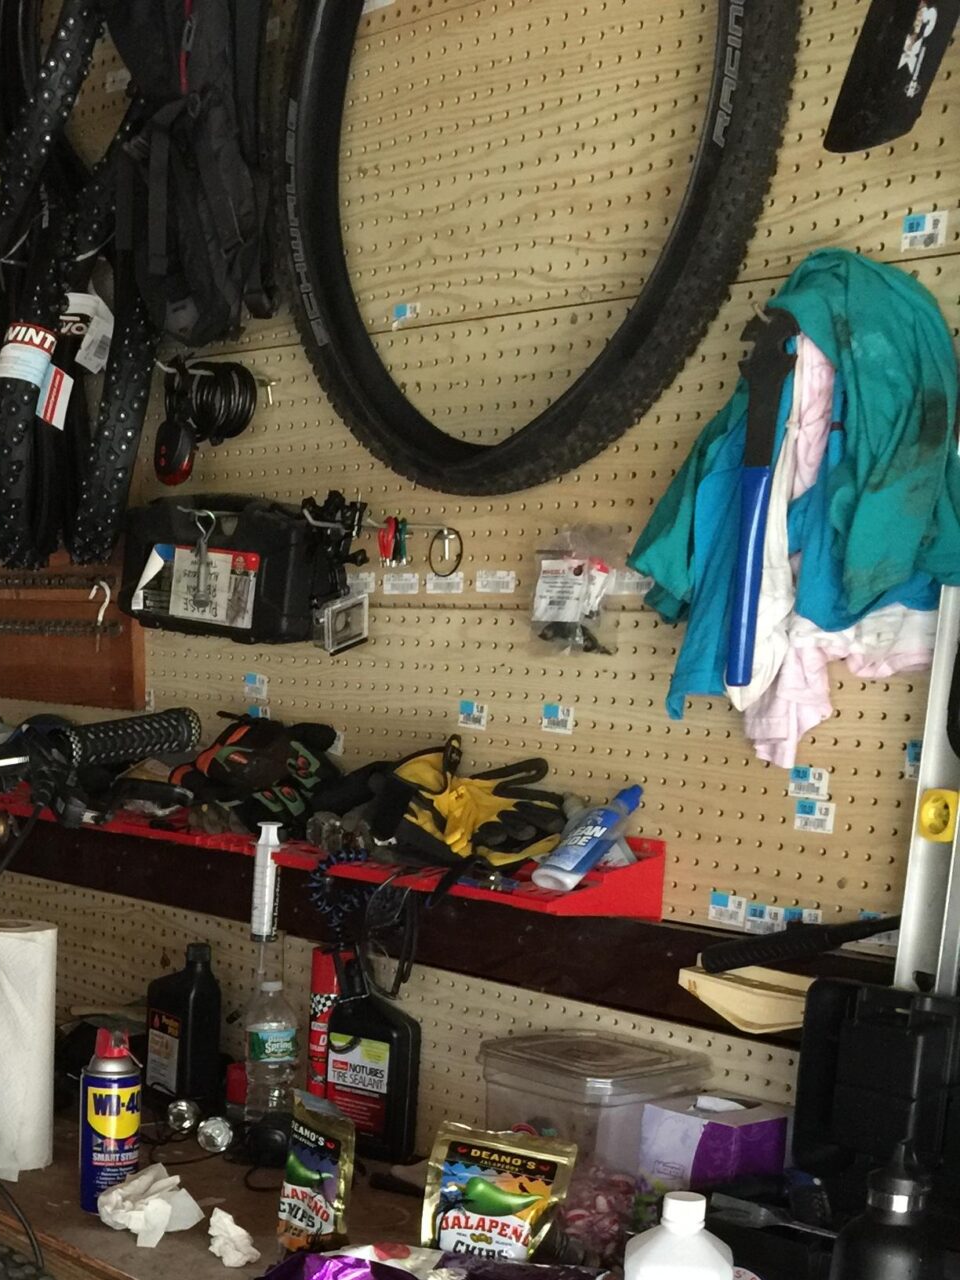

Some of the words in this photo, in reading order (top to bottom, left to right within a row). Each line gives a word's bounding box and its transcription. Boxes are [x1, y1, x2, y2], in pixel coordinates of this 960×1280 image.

[713, 0, 745, 147] RACIN
[4, 325, 58, 355] WINT
[264, 1041, 293, 1054] Spring
[331, 1069, 348, 1083] TIRE
[349, 1073, 384, 1090] SEALANT
[349, 1062, 384, 1079] NOTUBES
[470, 1148, 537, 1170] DEANO'S
